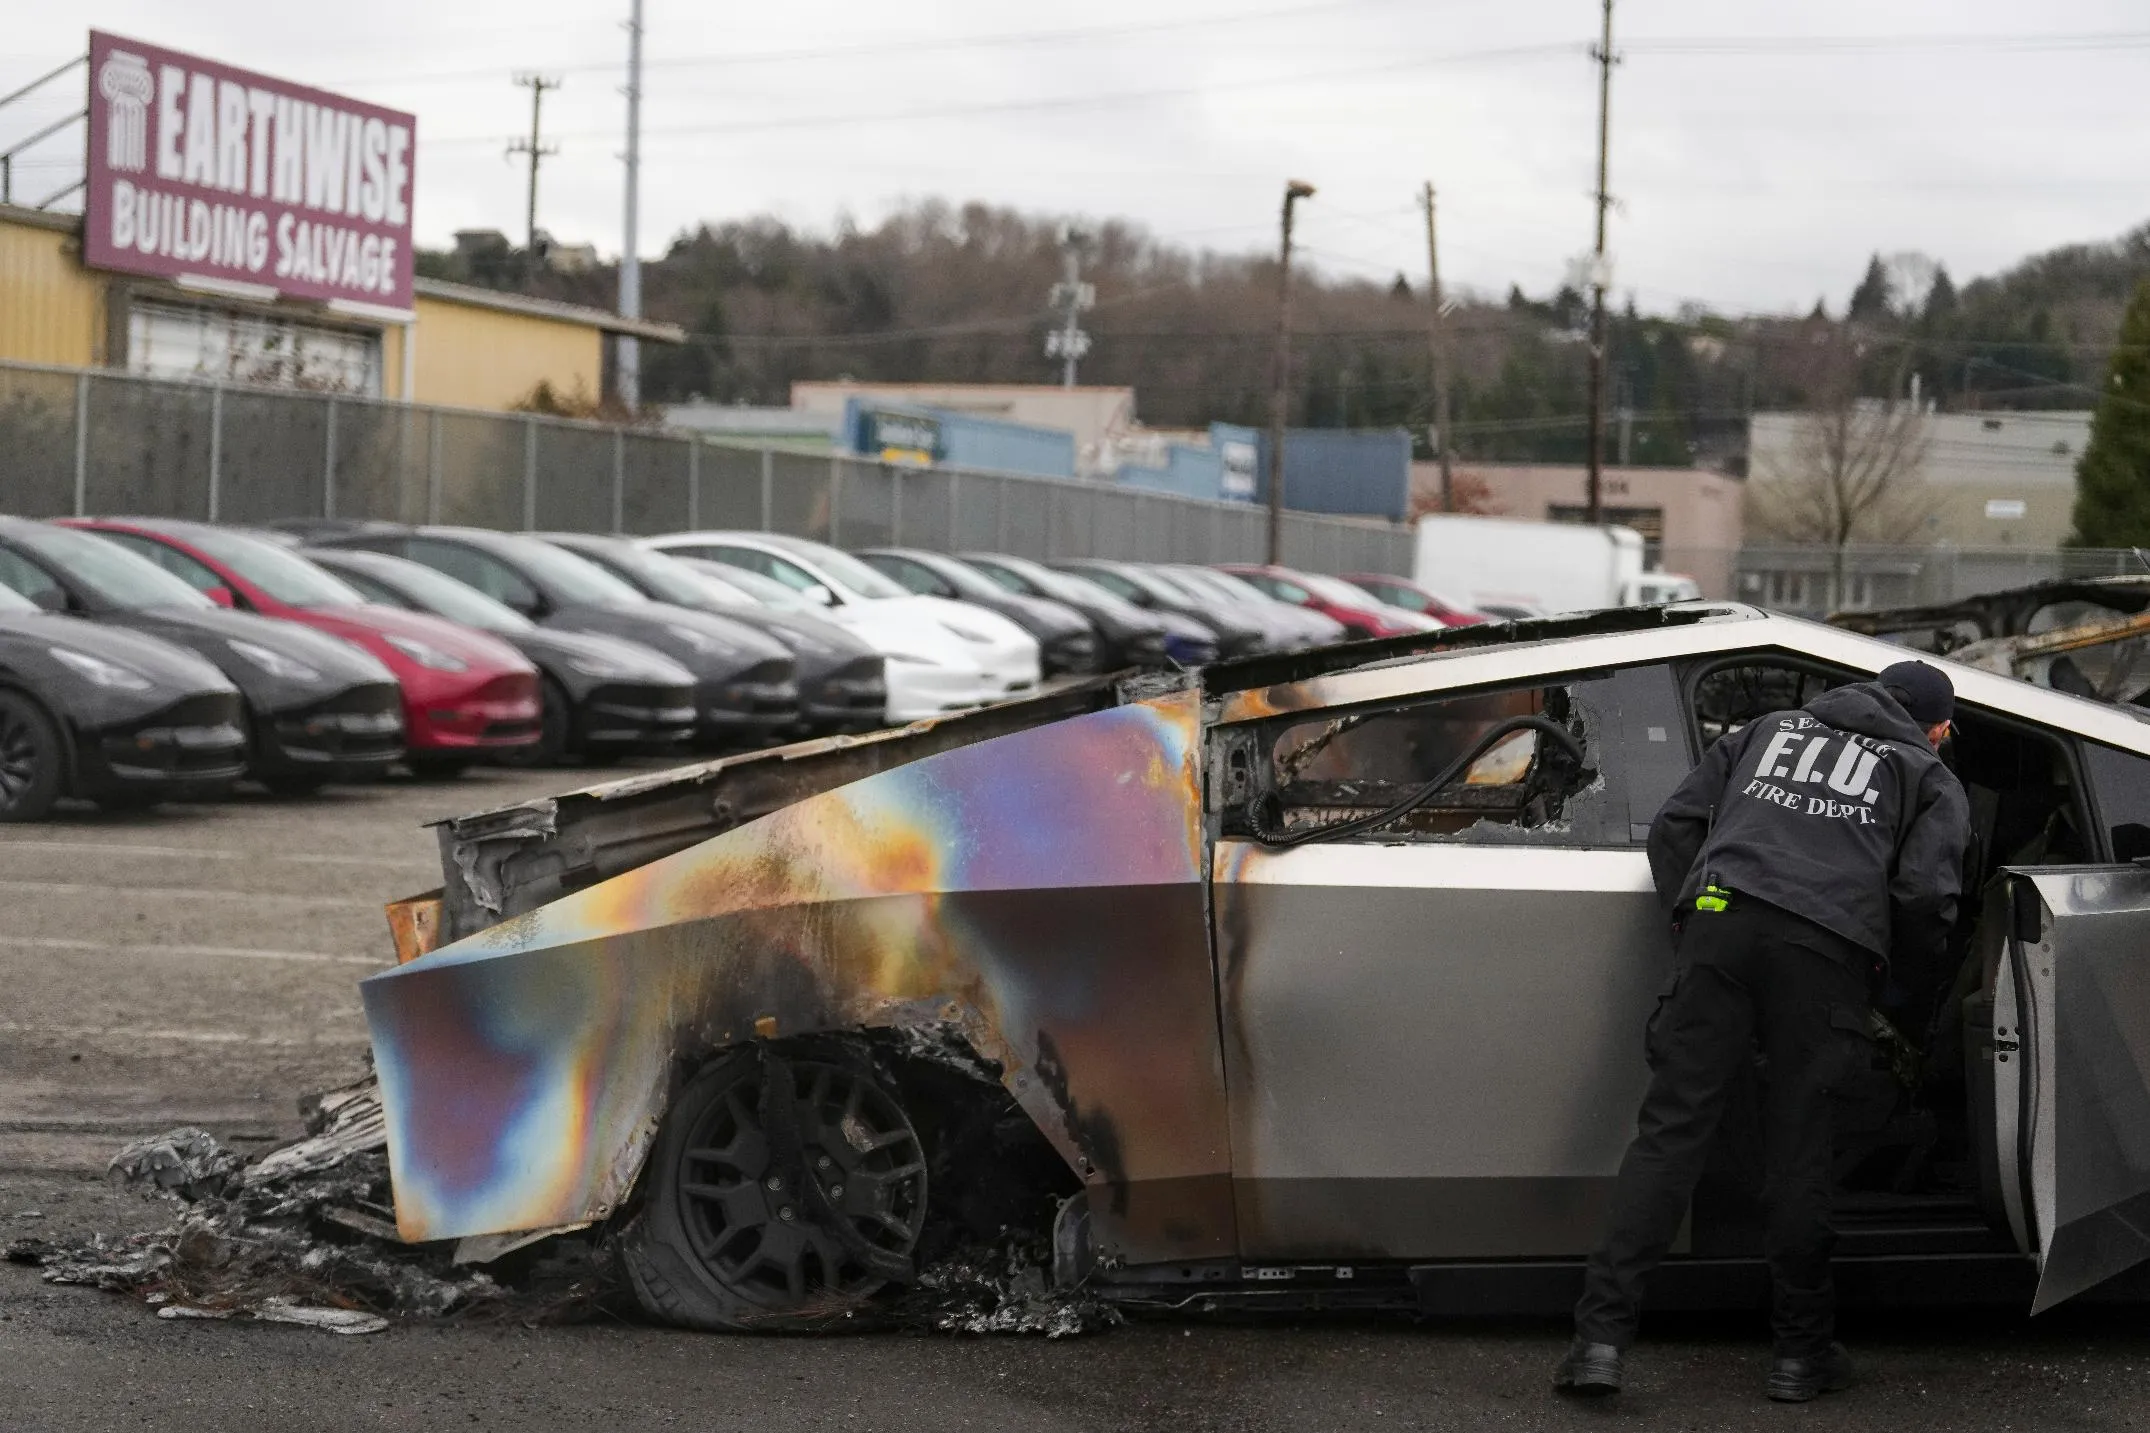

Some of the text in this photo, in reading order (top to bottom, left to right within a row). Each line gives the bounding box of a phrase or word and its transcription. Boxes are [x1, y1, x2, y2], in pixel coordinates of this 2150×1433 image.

[157, 64, 408, 226] EARTHWISE
[111, 178, 397, 295] BUILDING SALVAGE
[1755, 731, 1880, 805] F.I.U.
[1779, 717, 1897, 759] SELE
[1742, 779, 1876, 825] FIRE DEPT.
